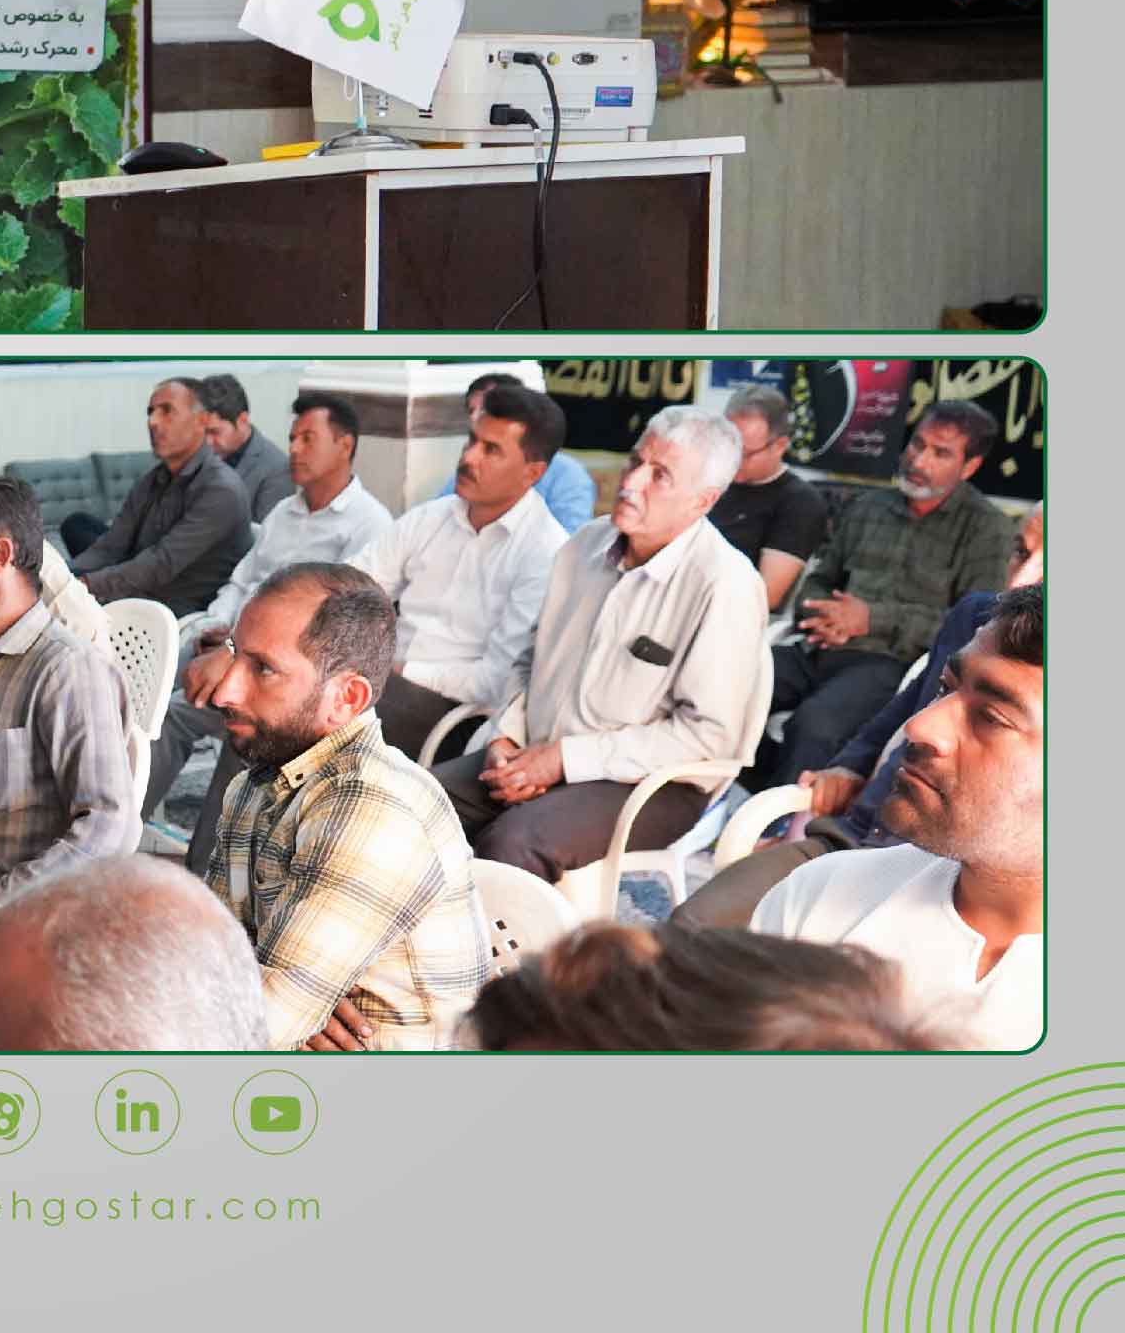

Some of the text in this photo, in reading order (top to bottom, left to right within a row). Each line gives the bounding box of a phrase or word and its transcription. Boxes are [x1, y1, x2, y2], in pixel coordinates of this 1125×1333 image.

[3, 7, 64, 26] خصوص
[68, 8, 84, 24] به
[34, 40, 77, 59] محرک
